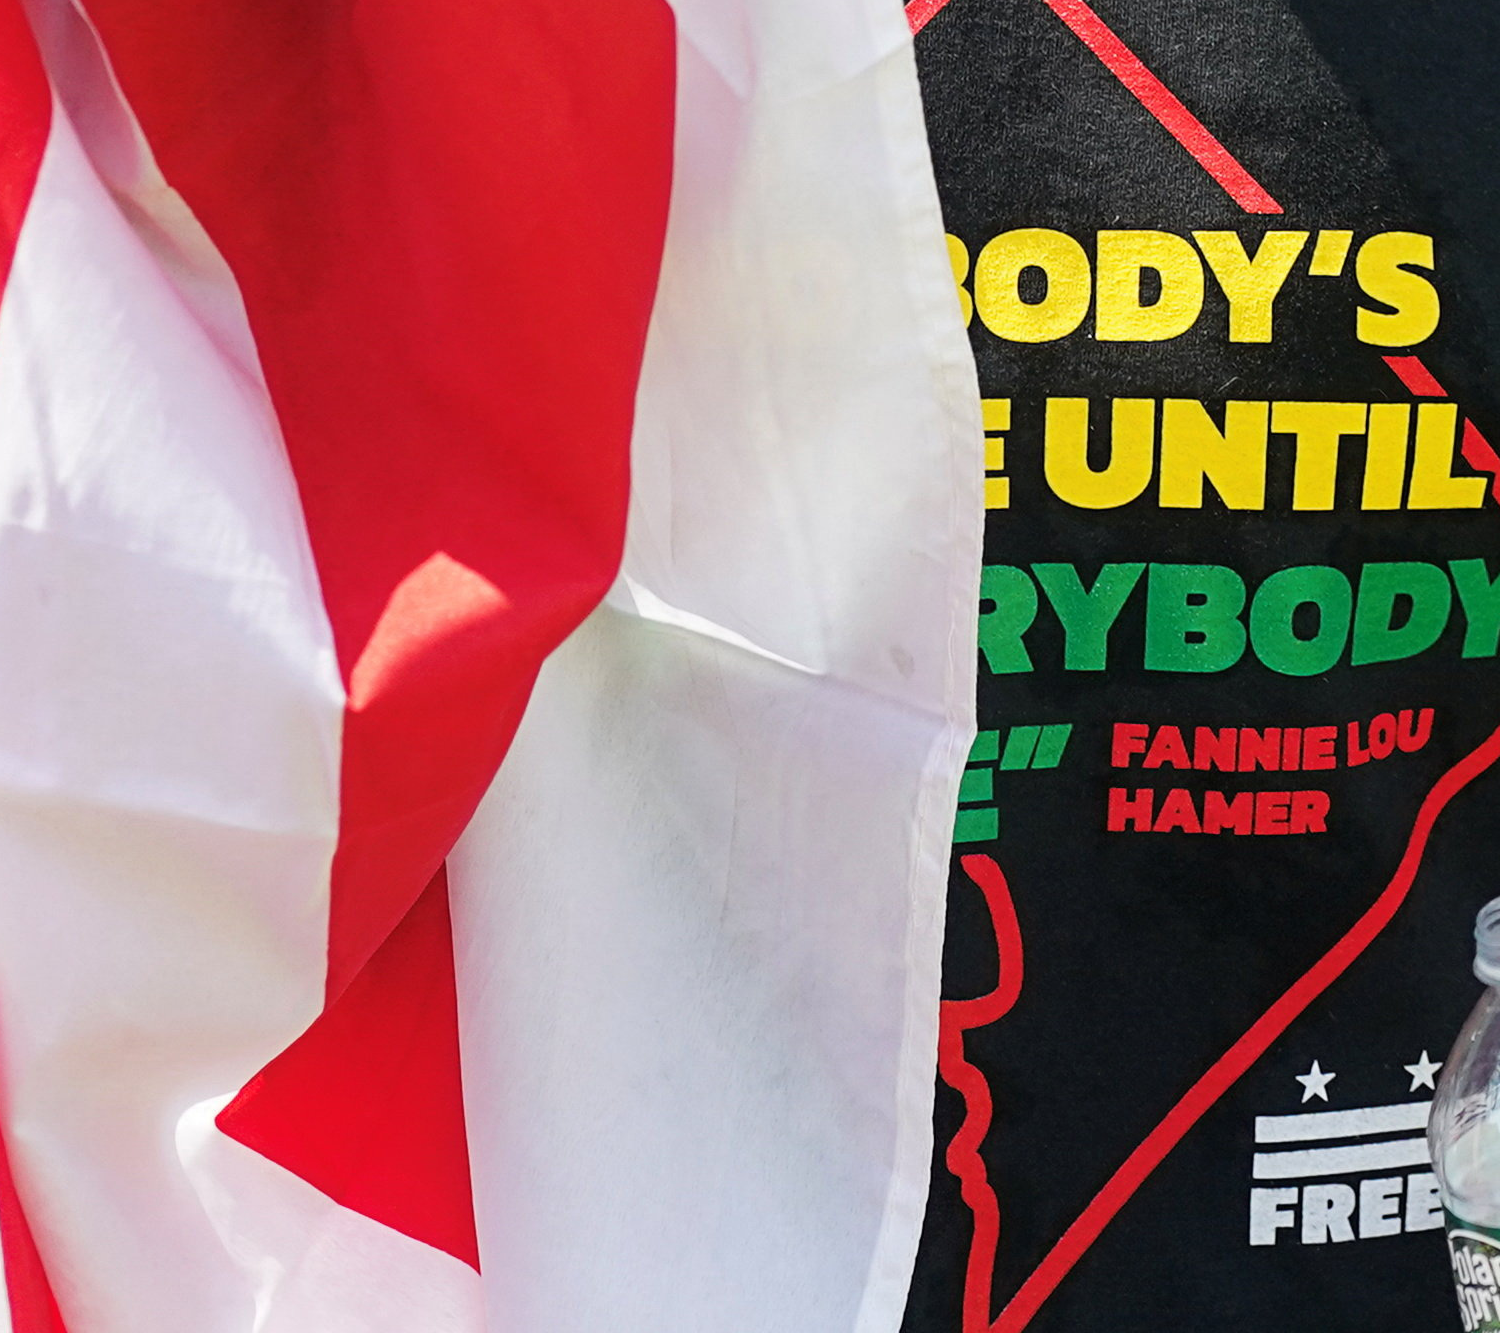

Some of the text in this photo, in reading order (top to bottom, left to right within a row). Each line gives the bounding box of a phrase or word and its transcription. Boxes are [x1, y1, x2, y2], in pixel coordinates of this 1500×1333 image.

[946, 227, 1442, 348] ODY'S
[1044, 397, 1489, 511] UNTIL
[1111, 722, 1338, 773] FANNIE
[1347, 707, 1434, 768] LOU
[1107, 787, 1331, 836] HAMER
[1250, 1171, 1445, 1245] FREE
